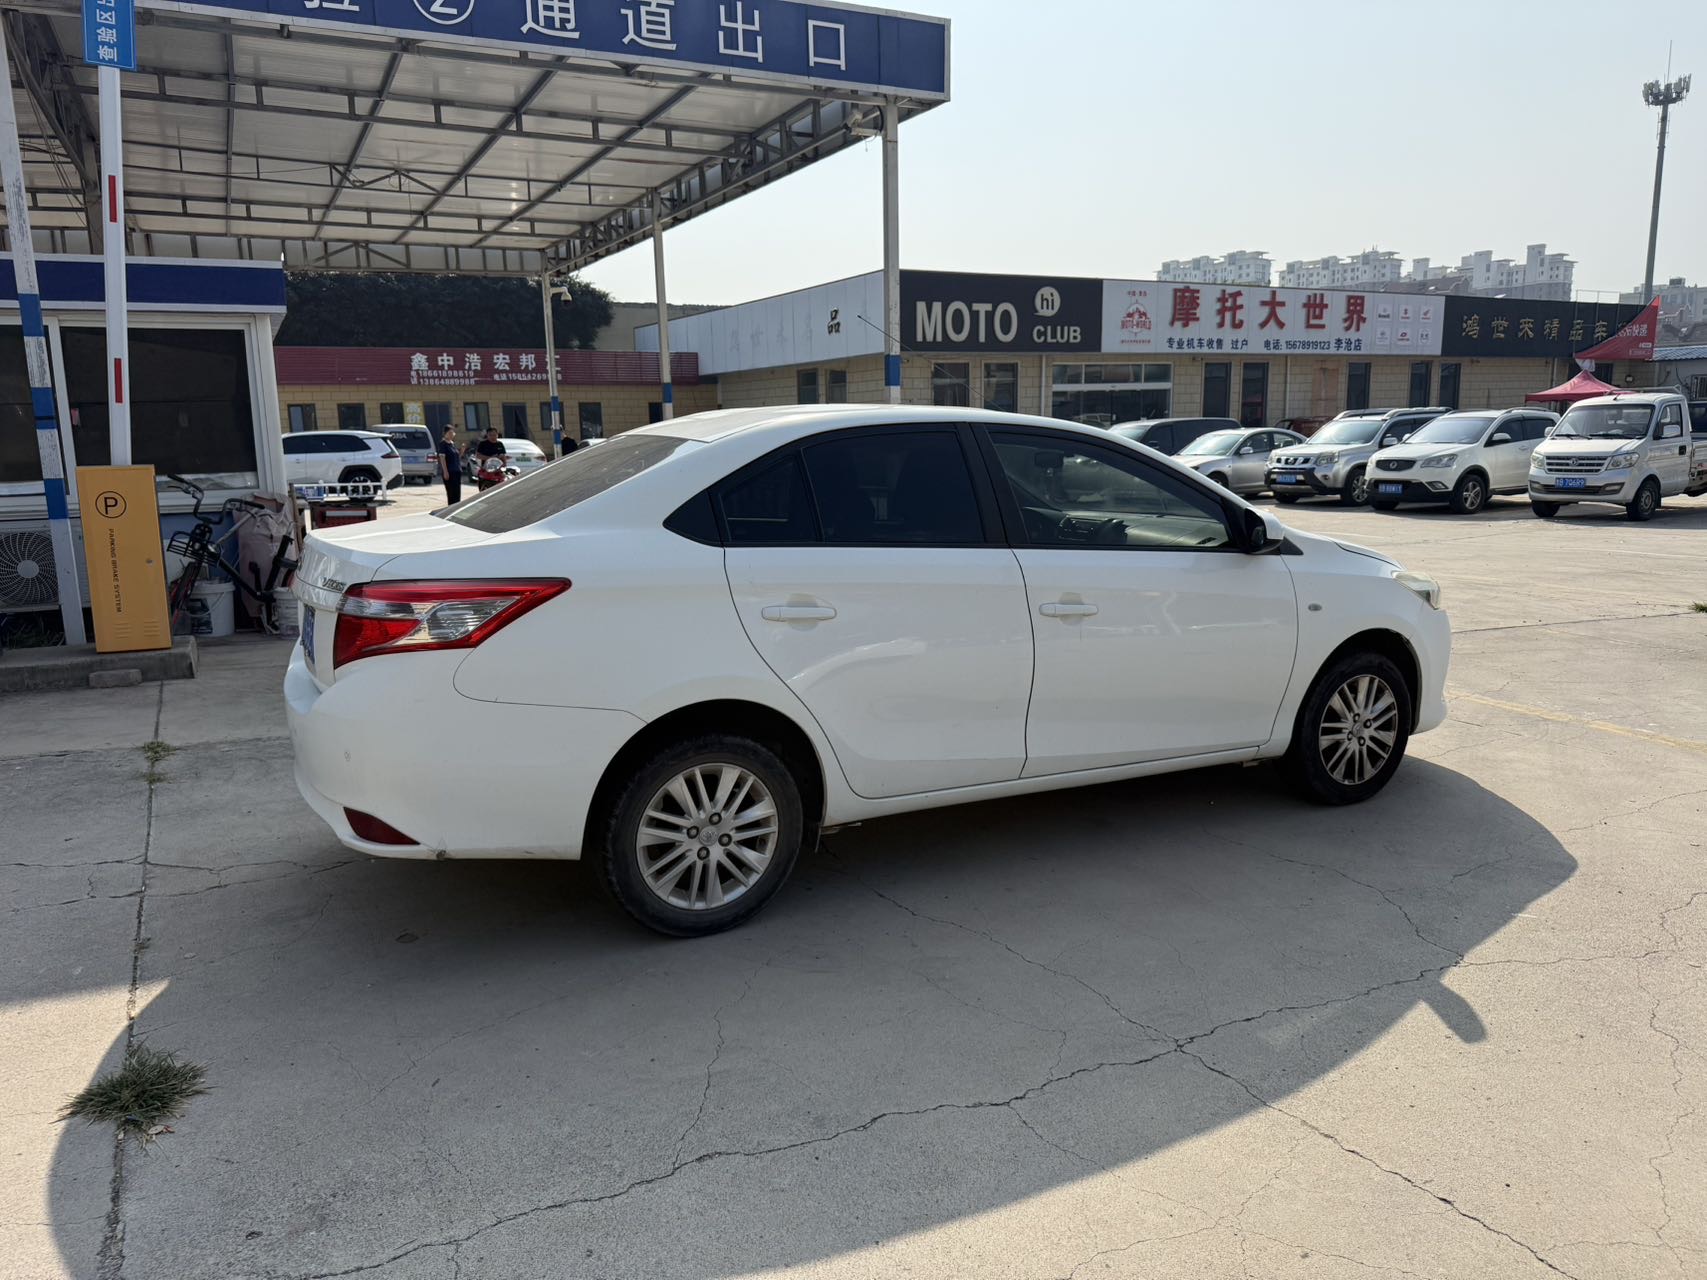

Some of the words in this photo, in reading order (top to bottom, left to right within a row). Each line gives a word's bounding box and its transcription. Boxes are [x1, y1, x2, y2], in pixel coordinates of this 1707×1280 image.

[1040, 293, 1055, 311] hi
[1169, 286, 1367, 332] 摩托大世界
[915, 300, 1018, 343] MOTO
[1032, 325, 1081, 343] CLUB
[1166, 337, 1224, 350] 专业机车收售
[1231, 338, 1249, 350] 过户
[1334, 338, 1362, 351] 李沧店
[109, 528, 117, 558] PARKING
[112, 560, 120, 582] BRAKE
[114, 584, 122, 612] SYSTEM
